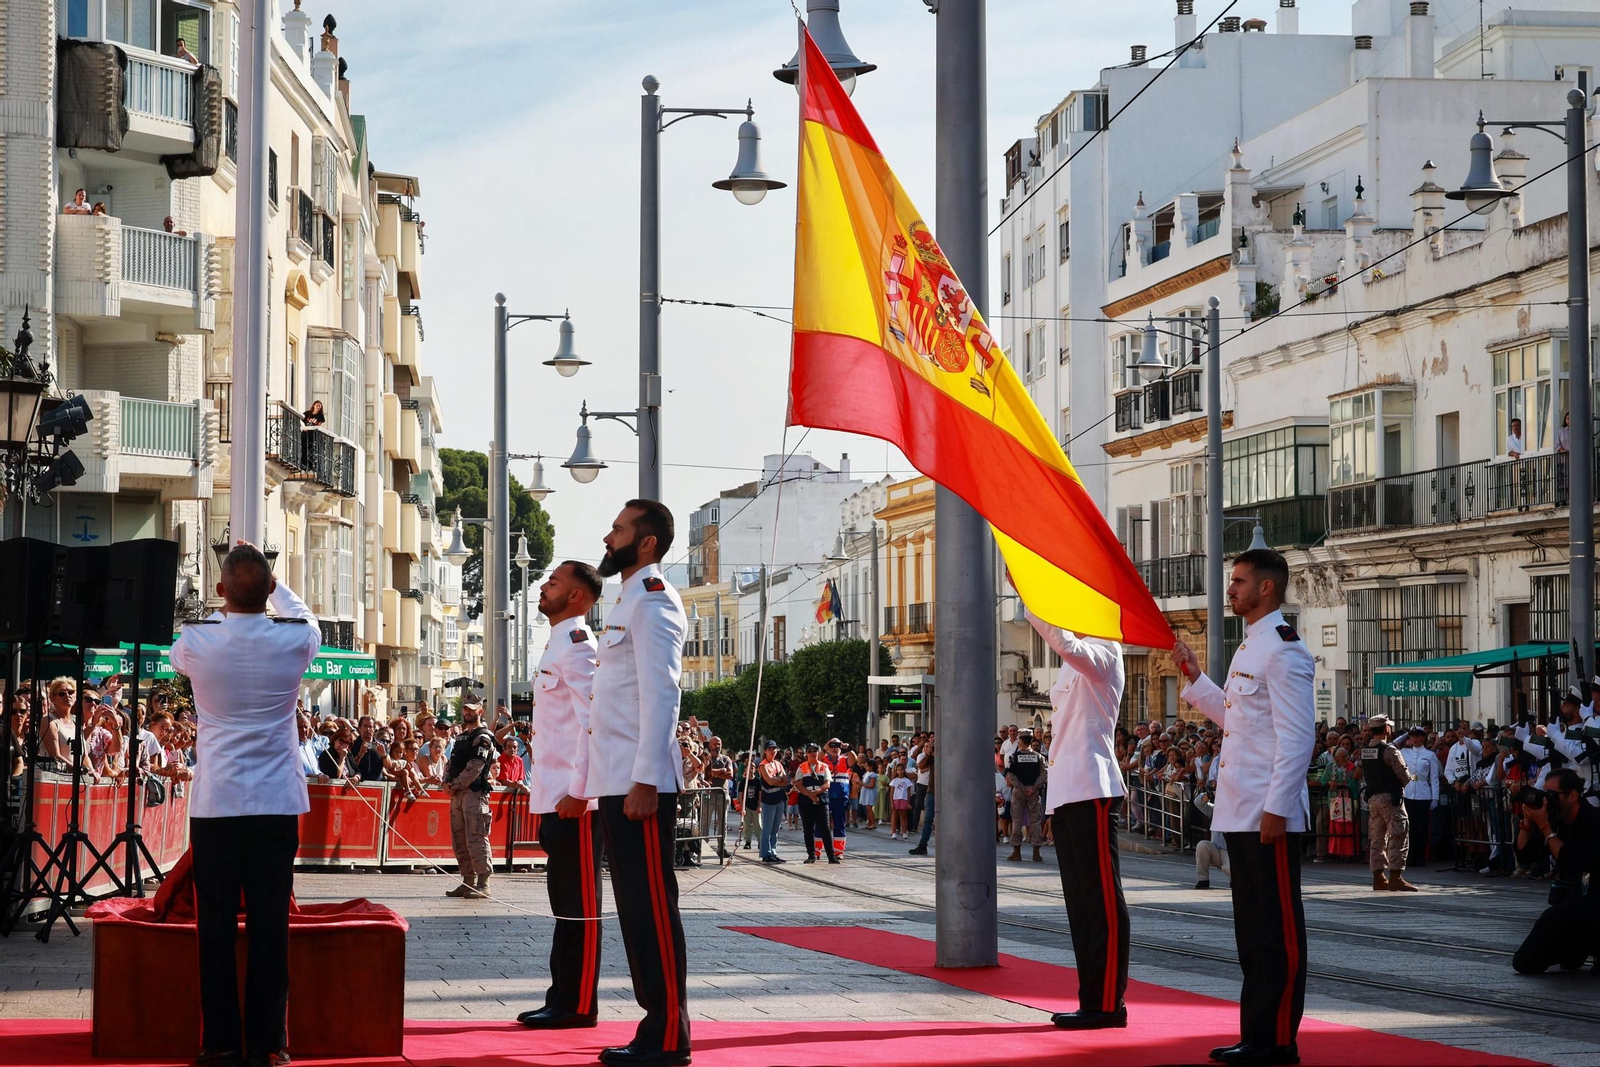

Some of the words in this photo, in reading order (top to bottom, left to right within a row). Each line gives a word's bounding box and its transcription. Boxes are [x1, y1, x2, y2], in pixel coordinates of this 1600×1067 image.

[83, 662, 114, 673] ruzcampo
[120, 658, 134, 674] Ba
[146, 661, 154, 673] El
[310, 663, 323, 674] Isla
[326, 660, 343, 675] Bar
[349, 665, 375, 675] Cruzcampo
[1392, 678, 1405, 692] CAFÉ
[1408, 680, 1419, 692] BAR
[1420, 680, 1427, 692] LA
[477, 746, 489, 759] PN
